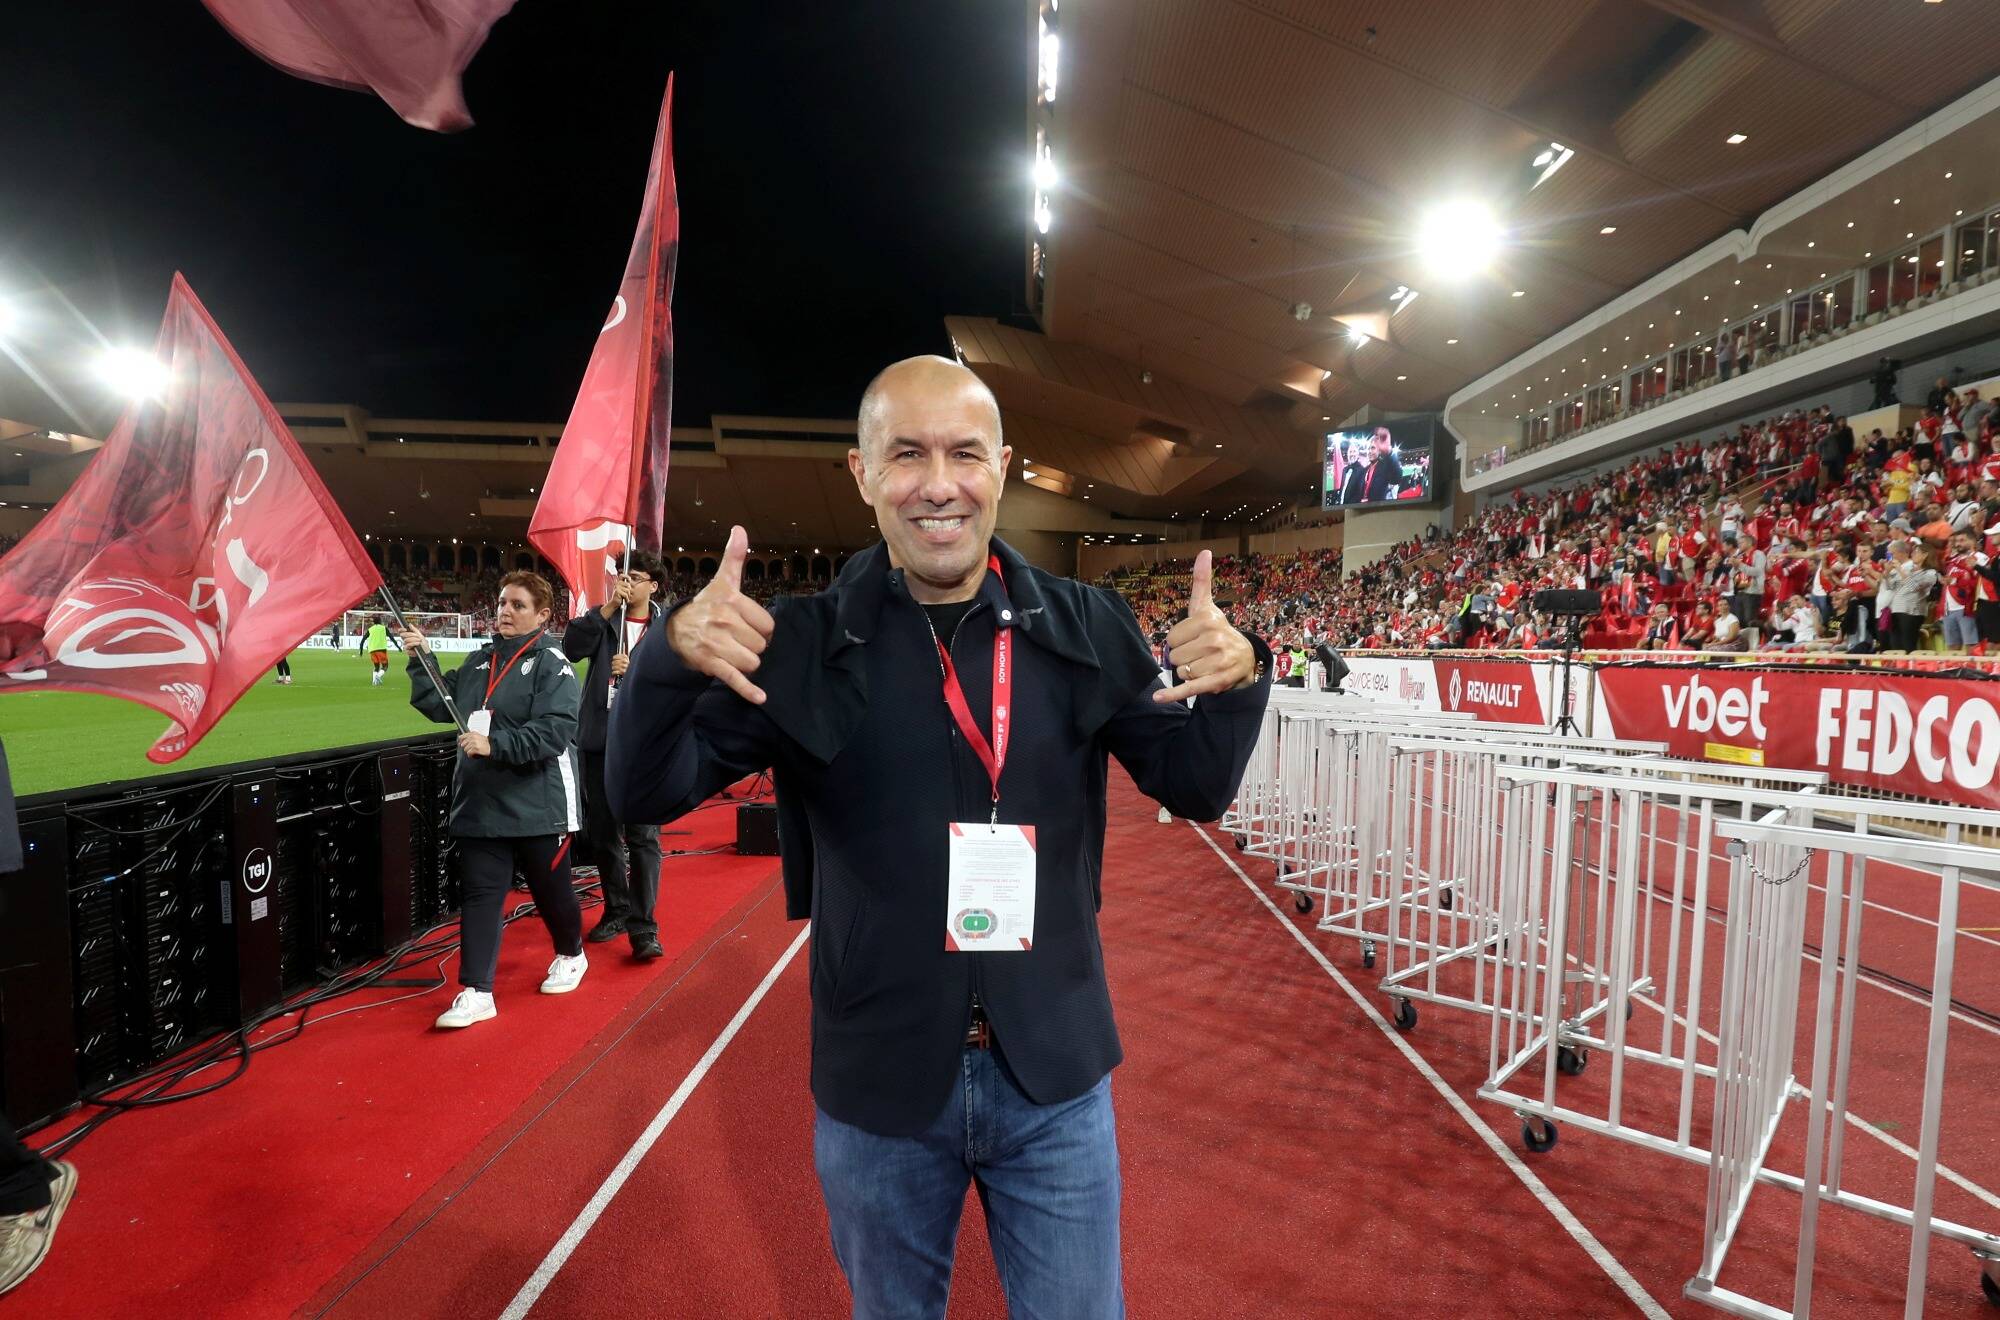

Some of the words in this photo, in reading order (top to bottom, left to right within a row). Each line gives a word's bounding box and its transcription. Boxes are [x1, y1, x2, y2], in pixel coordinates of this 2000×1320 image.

[1372, 672, 1389, 692] 1924
[1467, 680, 1522, 708] RENAULT
[1661, 674, 1770, 741] vbet
[1816, 687, 2000, 789] FEDCO
[248, 862, 265, 879] TGI
